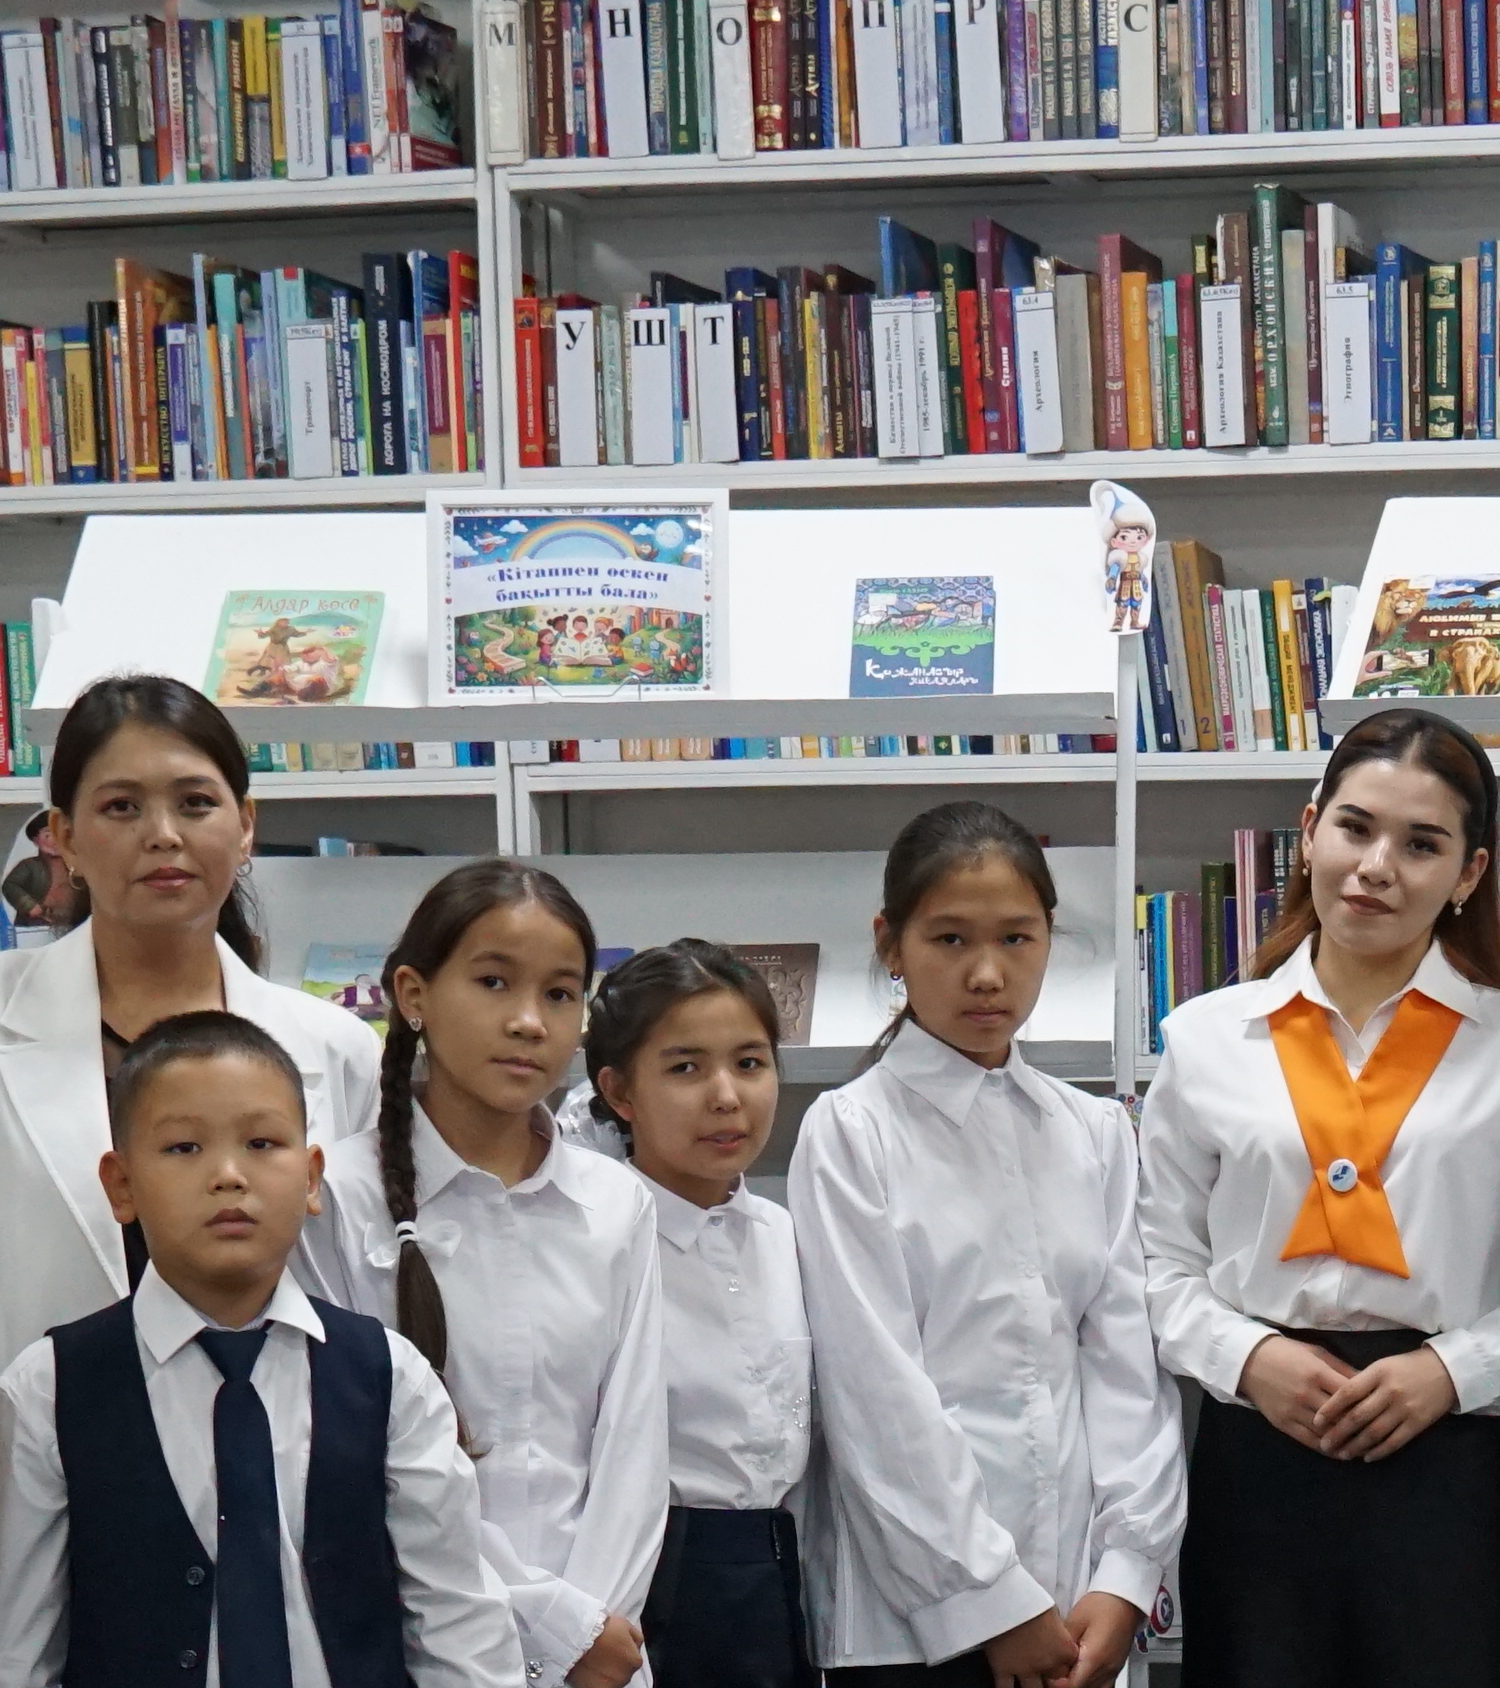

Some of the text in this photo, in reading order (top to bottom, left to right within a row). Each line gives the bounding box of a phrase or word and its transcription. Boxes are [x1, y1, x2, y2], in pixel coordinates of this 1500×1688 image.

[608, 9, 632, 38] Н
[716, 18, 741, 46] О
[1123, 4, 1148, 32] С
[489, 23, 515, 46] М
[1263, 254, 1278, 361] ОРХОНСКИХ
[561, 321, 586, 351] У
[633, 319, 665, 346] Ш
[702, 316, 724, 345] Т
[1000, 347, 1011, 386] Сталин
[378, 320, 394, 465] ДОРОГА НА КОСМОДРОМ
[1032, 351, 1044, 412] Археология
[487, 566, 668, 582] «Кітаппен өскен
[496, 583, 658, 602] бақытты бала»
